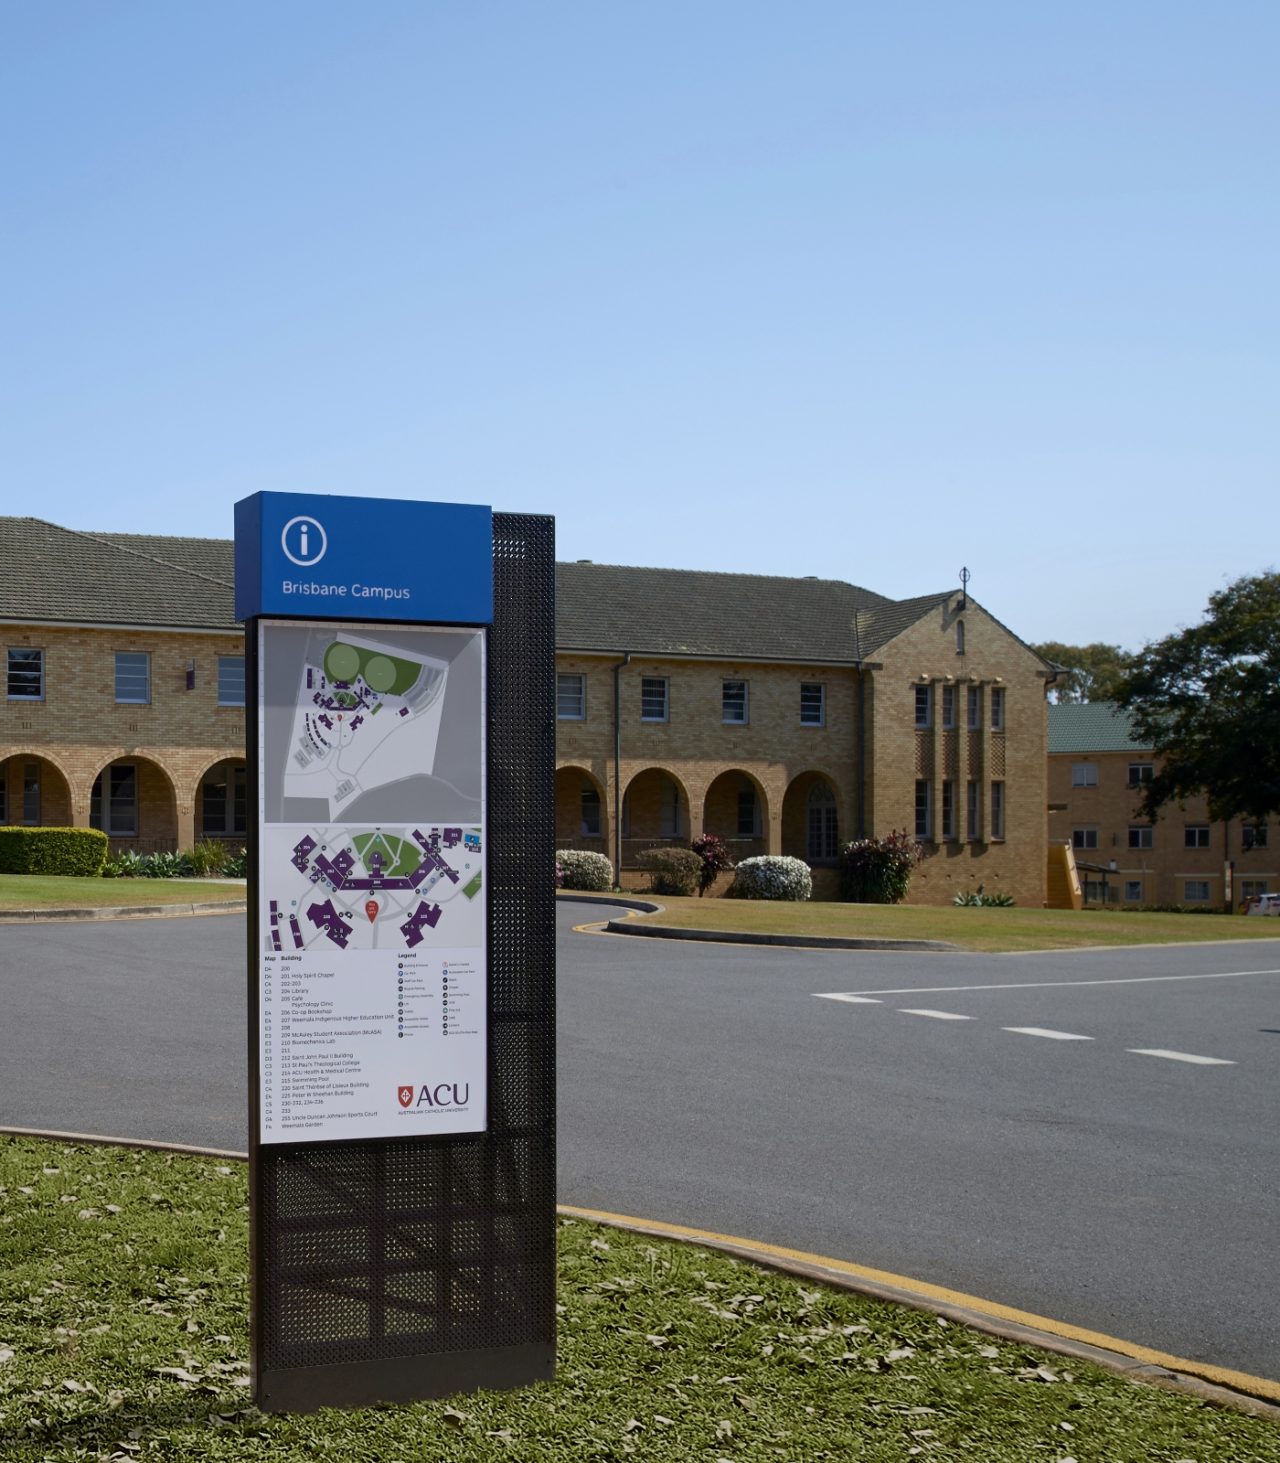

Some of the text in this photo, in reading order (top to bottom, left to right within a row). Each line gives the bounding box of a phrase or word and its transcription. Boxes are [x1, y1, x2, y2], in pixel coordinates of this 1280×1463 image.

[282, 580, 410, 600] Brisbane Campus
[416, 1082, 469, 1107] ACU
